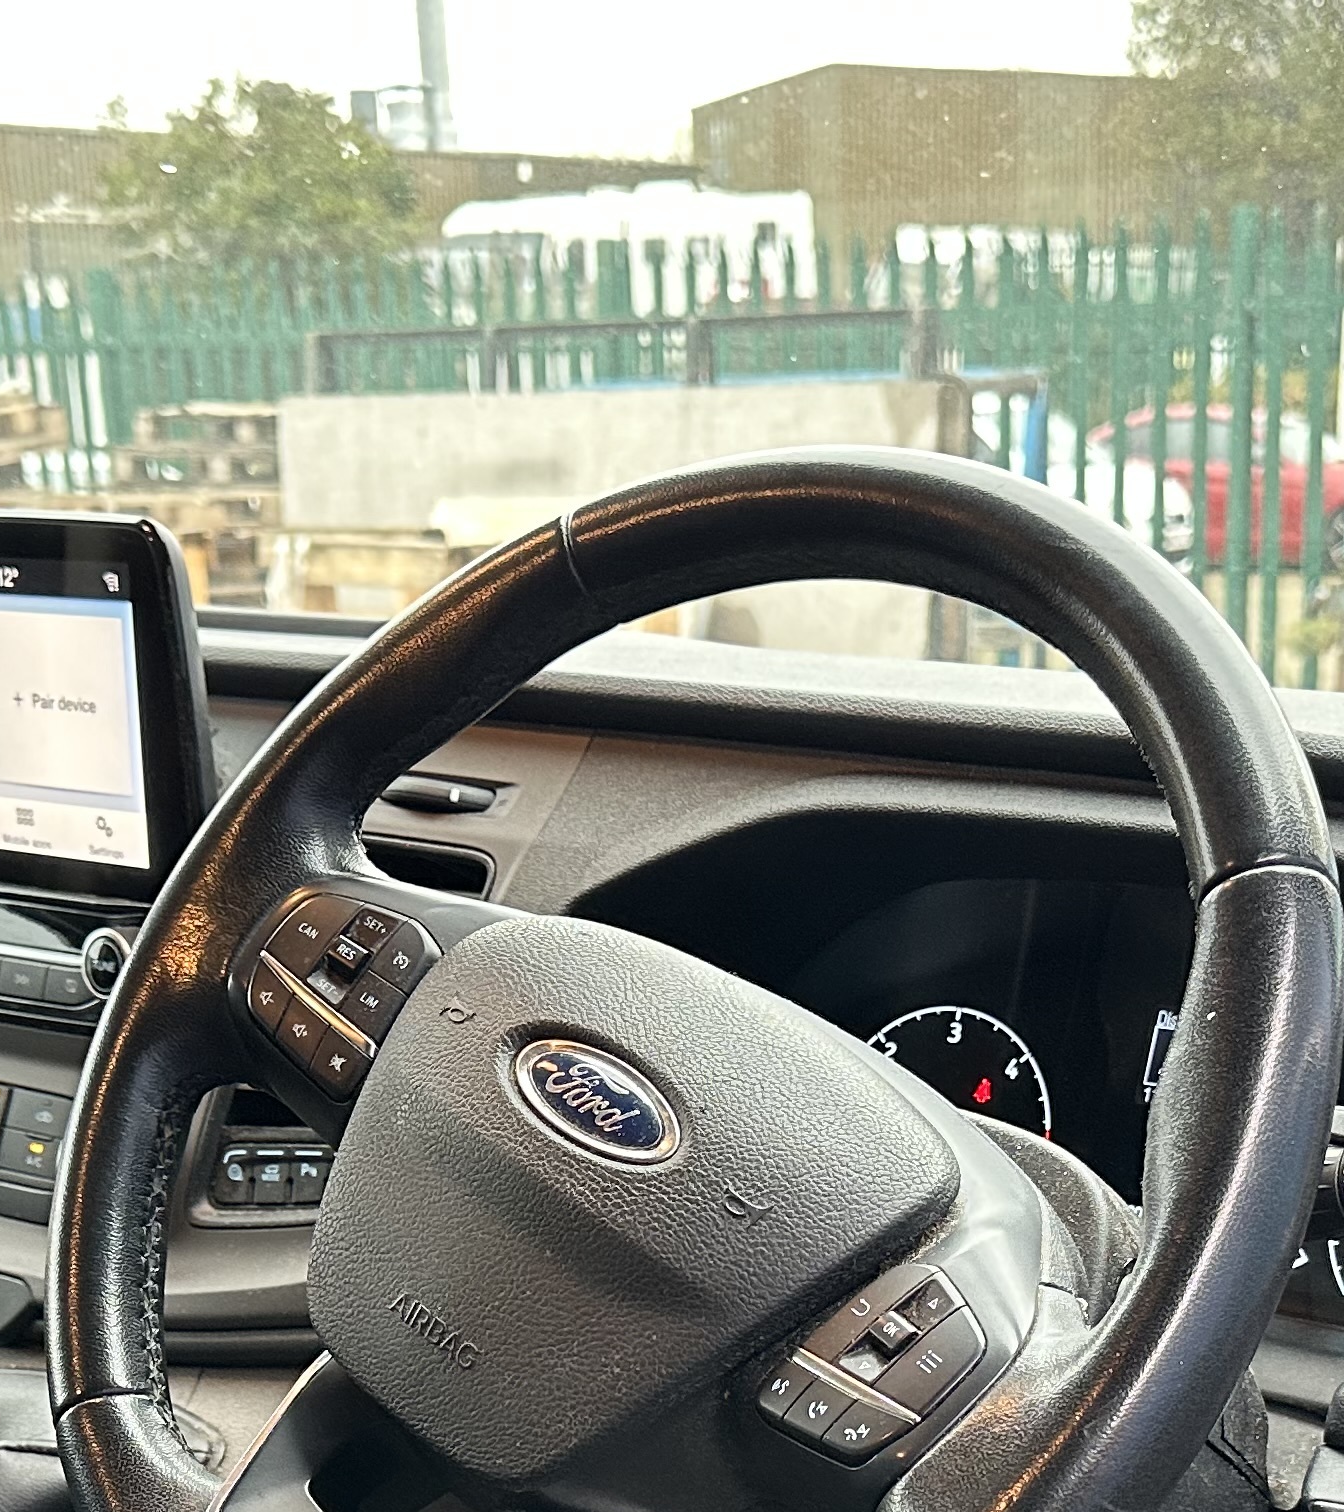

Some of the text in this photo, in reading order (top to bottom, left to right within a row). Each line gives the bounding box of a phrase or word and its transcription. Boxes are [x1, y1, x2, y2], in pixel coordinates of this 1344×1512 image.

[31, 692, 97, 714] Pair device
[298, 922, 319, 940] CAN
[337, 943, 356, 960] RES
[359, 992, 379, 1009] LIM
[946, 1022, 963, 1043] 3
[884, 1042, 898, 1060] 2
[1005, 1058, 1020, 1079] 4
[545, 1063, 641, 1132] Ford
[388, 1293, 485, 1368] AIRBAG
[882, 1321, 901, 1337] OK
